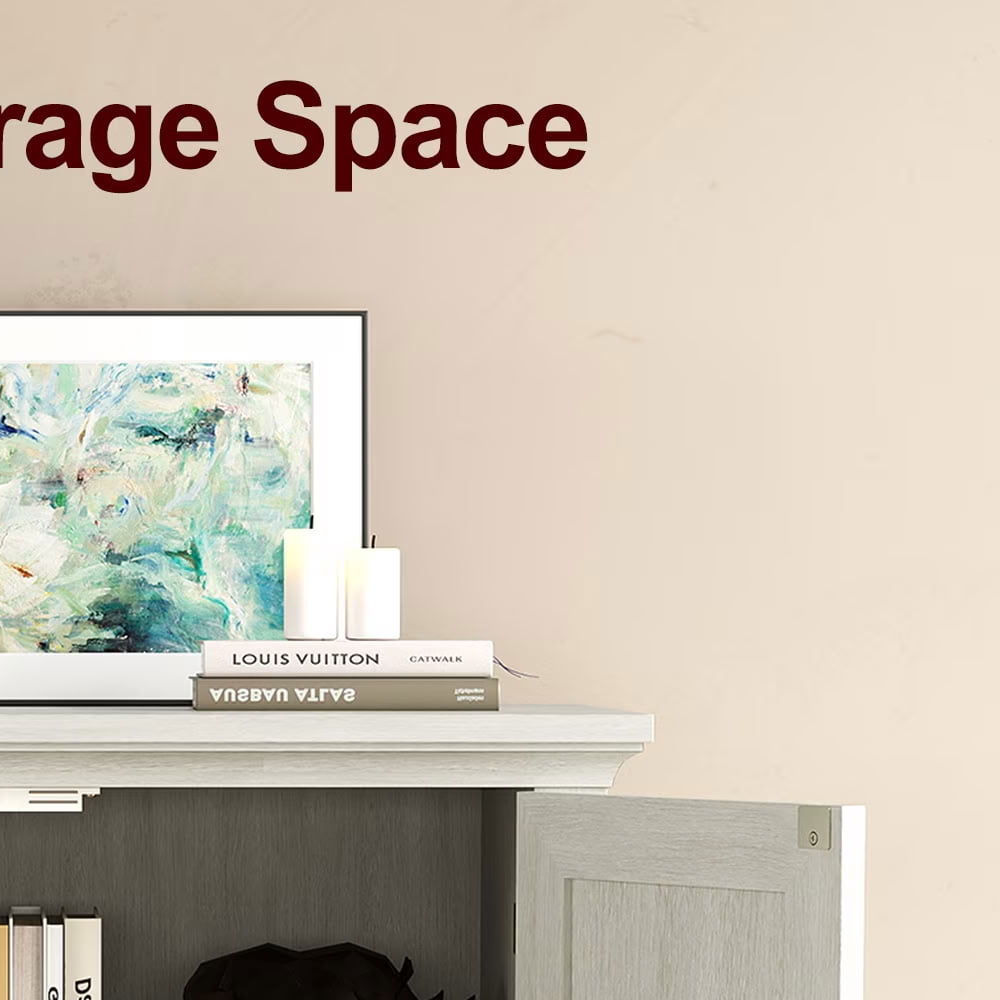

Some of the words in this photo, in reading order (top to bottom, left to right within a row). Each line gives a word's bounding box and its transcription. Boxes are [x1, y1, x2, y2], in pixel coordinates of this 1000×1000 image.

[232, 653, 290, 666] LOUIS
[296, 653, 380, 666] VUITTON
[409, 655, 463, 664] CATWALK
